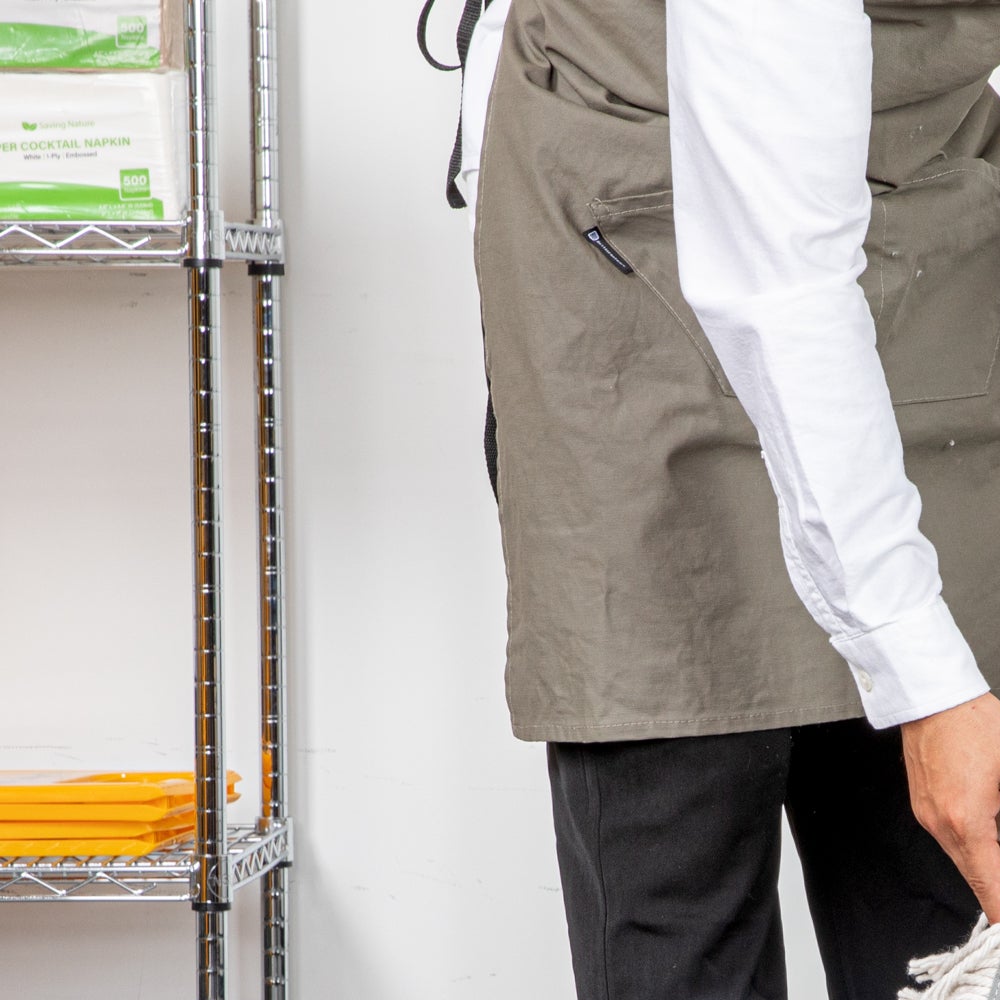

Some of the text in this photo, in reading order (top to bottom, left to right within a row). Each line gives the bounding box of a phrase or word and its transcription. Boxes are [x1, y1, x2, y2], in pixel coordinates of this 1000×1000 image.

[39, 119, 96, 130] Saving Nature
[20, 138, 81, 151] COCKTAIL
[84, 136, 131, 148] NAPKIN
[24, 152, 41, 161] White
[65, 150, 98, 159] Embossed
[123, 175, 148, 186] 500
